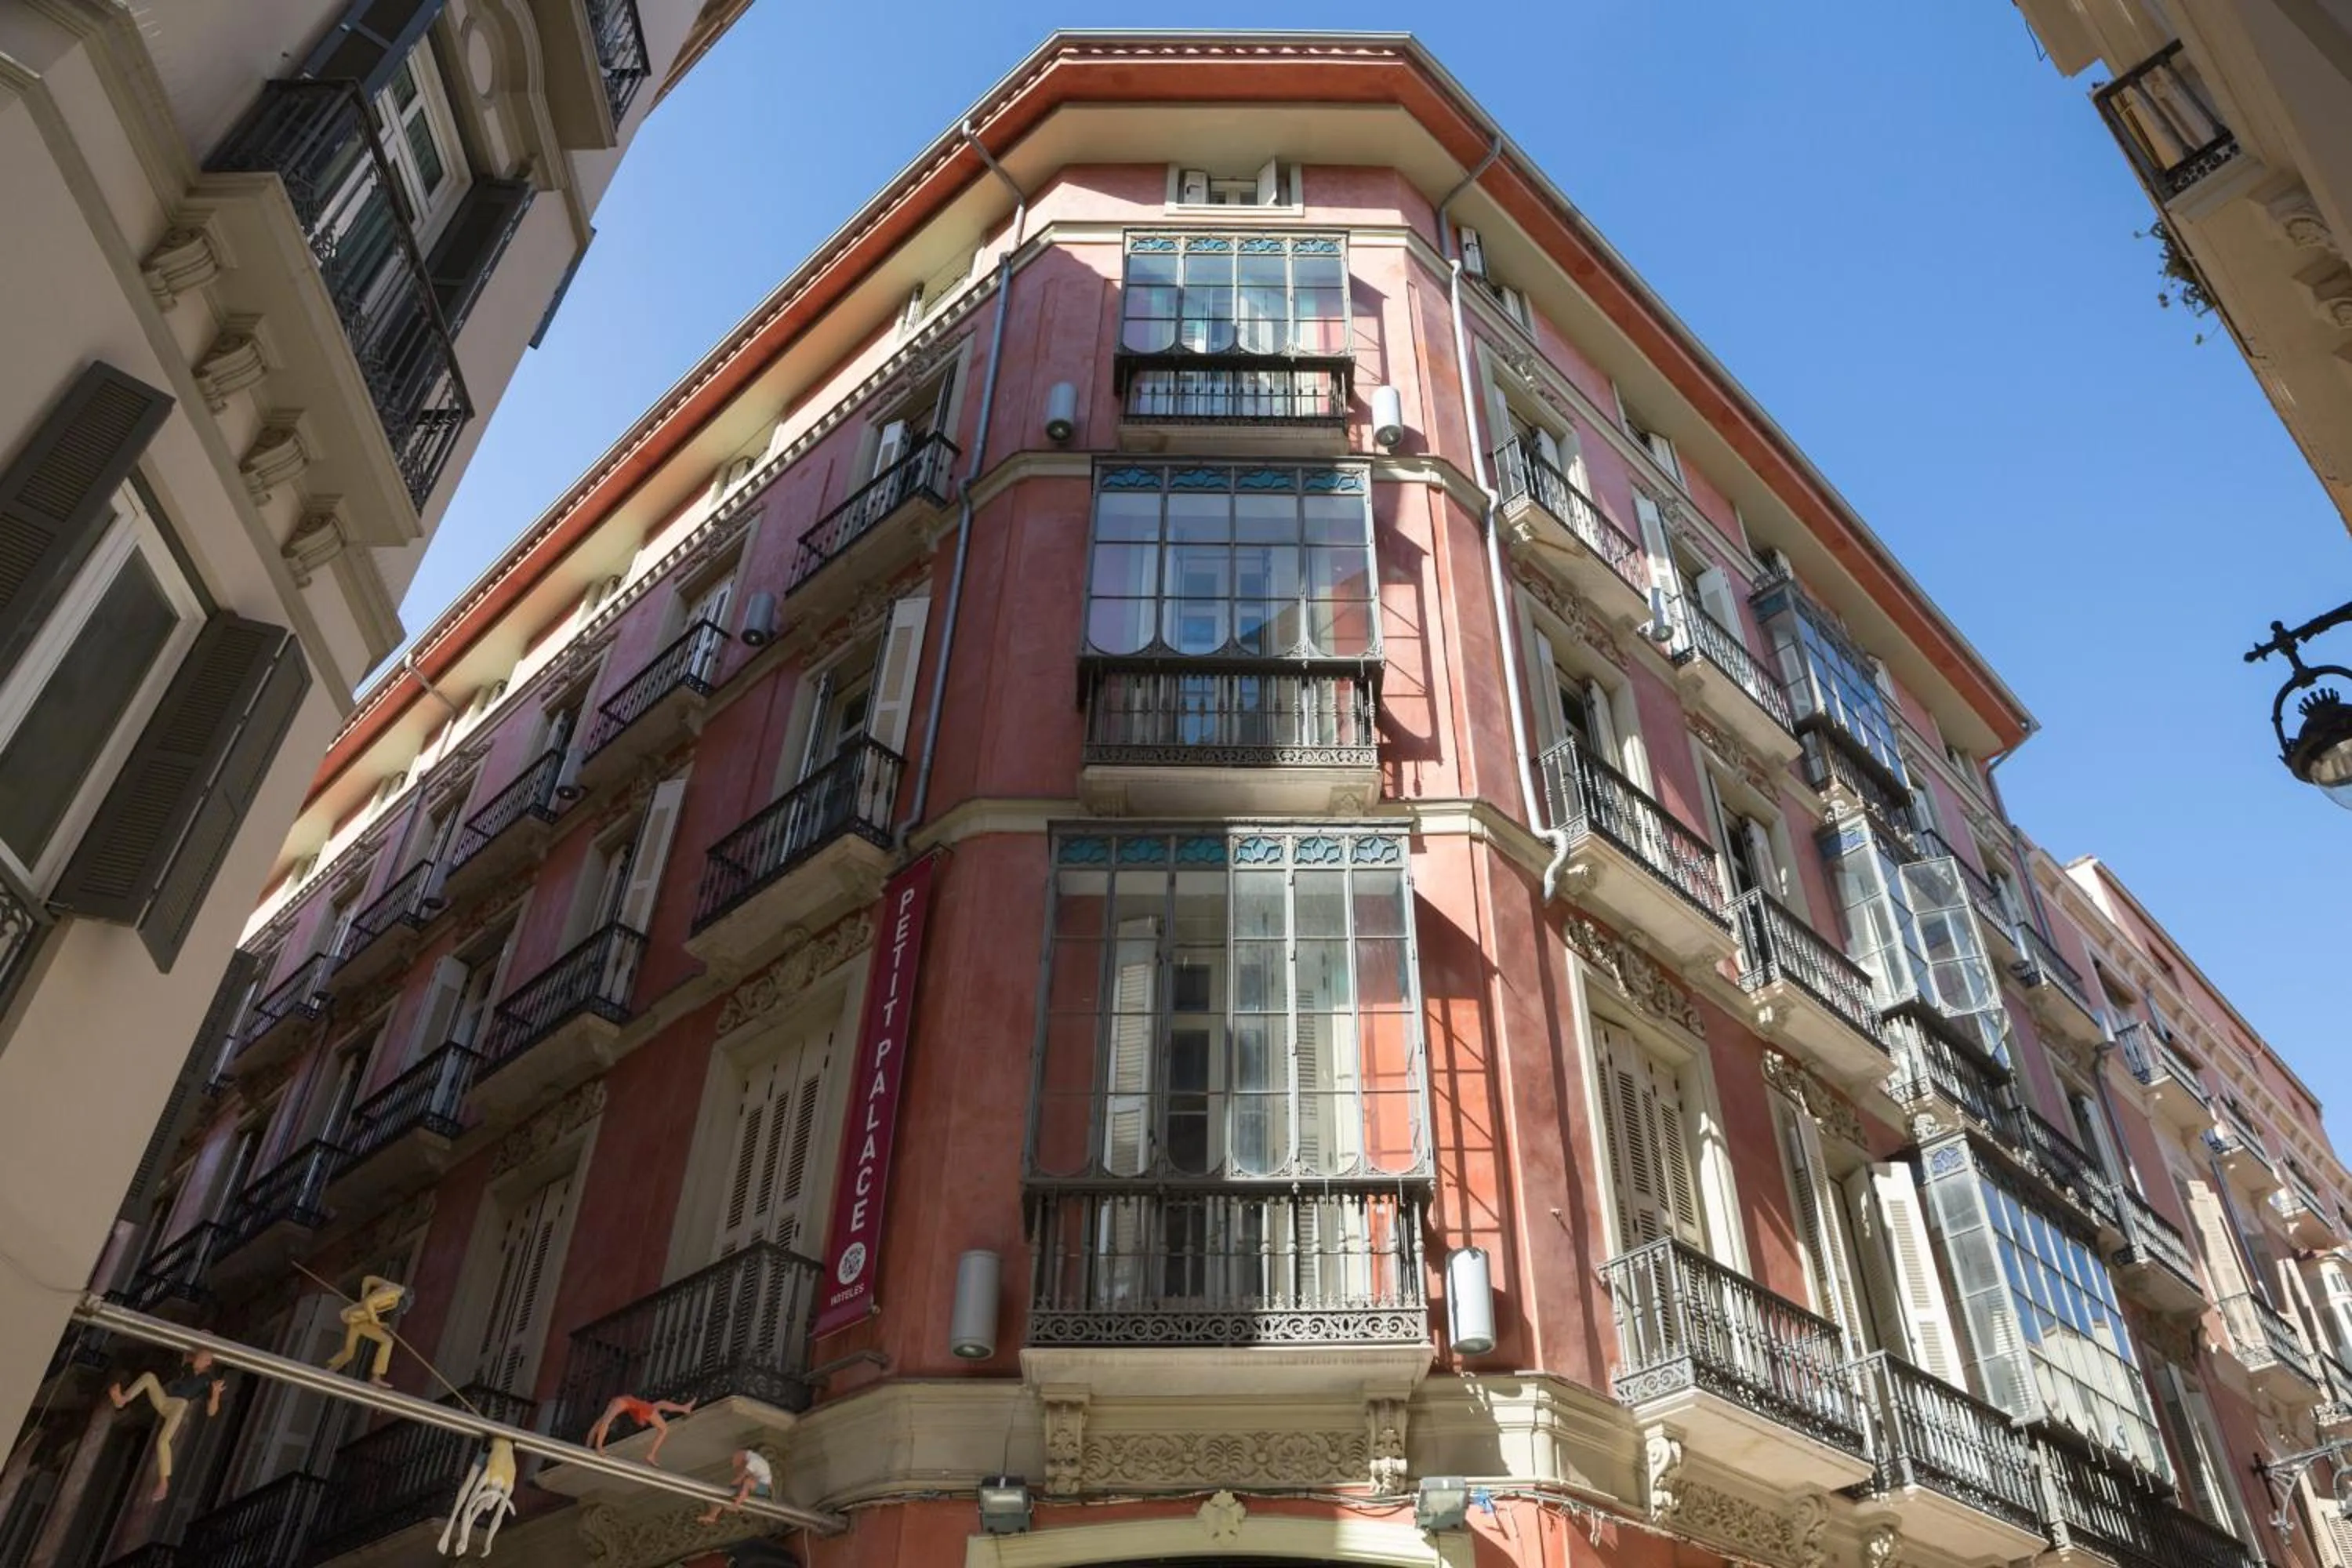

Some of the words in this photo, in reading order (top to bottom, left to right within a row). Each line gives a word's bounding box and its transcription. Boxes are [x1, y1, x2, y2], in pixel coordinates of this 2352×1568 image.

[884, 887, 915, 1028] PETIT
[851, 1038, 891, 1232] PALACE
[830, 1283, 865, 1306] HOTELES
